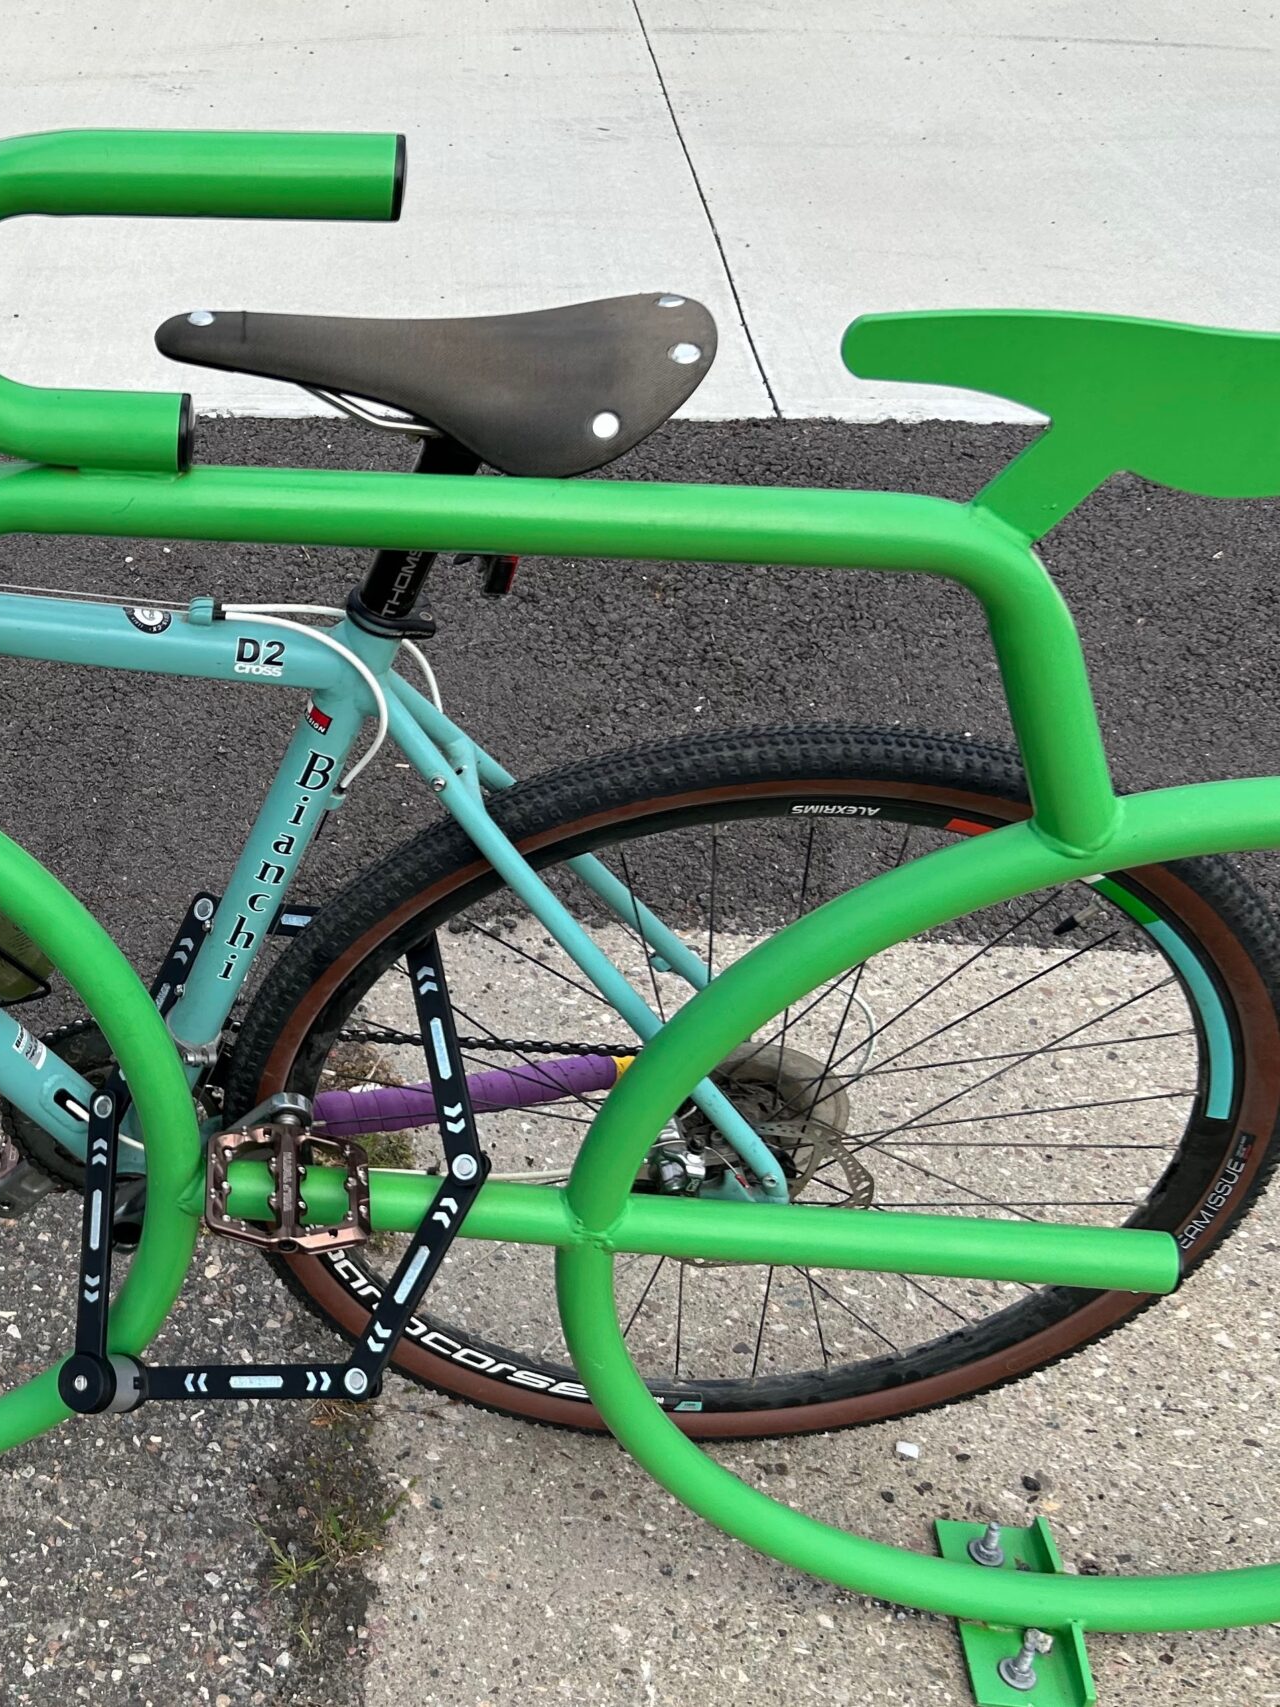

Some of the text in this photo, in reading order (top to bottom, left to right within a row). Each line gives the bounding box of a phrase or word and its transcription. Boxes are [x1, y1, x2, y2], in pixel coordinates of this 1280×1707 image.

[234, 636, 286, 667] D2
[234, 662, 283, 677] cross
[791, 804, 881, 816] ALEXRIMS
[217, 750, 335, 981] Bianchi
[1177, 1209, 1215, 1249] EAM
[1204, 1158, 1246, 1211] ISSUE
